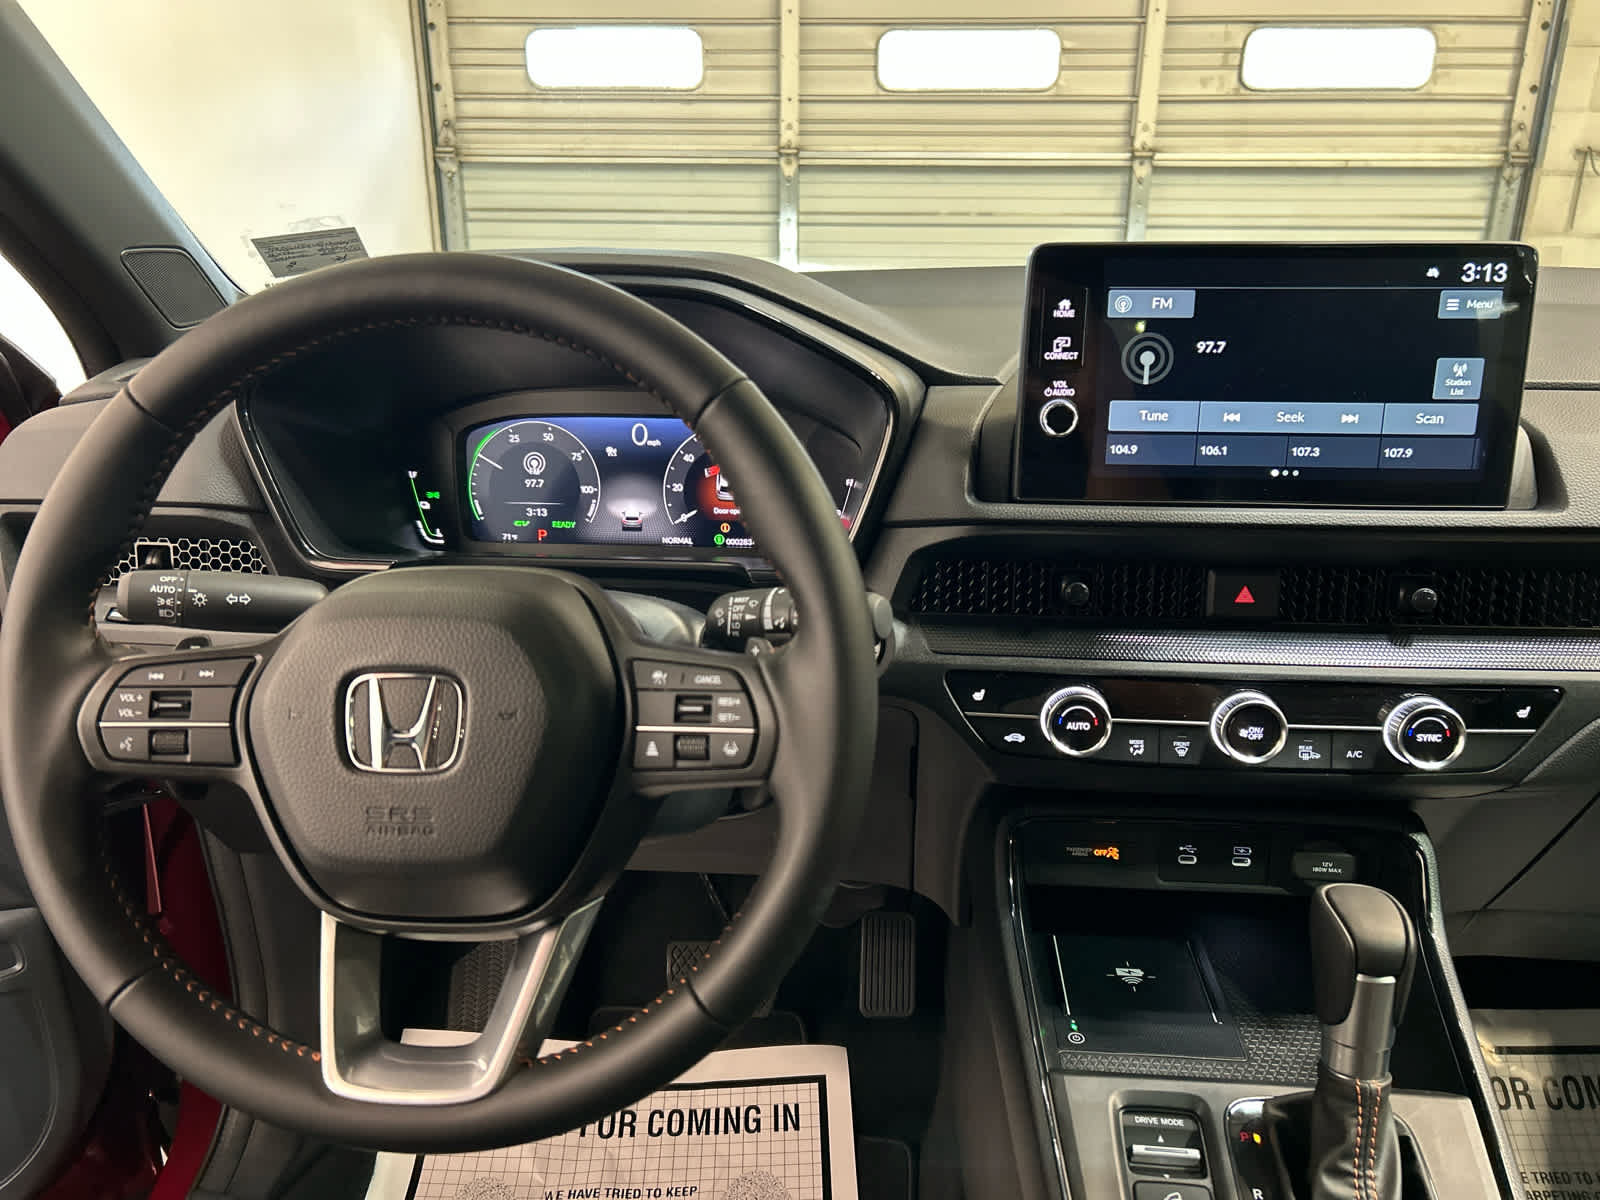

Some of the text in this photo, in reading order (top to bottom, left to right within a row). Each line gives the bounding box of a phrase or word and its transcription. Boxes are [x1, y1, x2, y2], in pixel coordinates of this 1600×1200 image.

[1460, 262, 1508, 283] 3:13
[1151, 297, 1173, 310] FM
[1466, 299, 1494, 309] Menu
[1053, 309, 1076, 318] HOME
[1196, 341, 1226, 354] 97.7
[1044, 351, 1079, 360] CONNECT
[1053, 380, 1068, 388] VOL
[1445, 378, 1472, 387] Station
[1052, 388, 1076, 397] AUDIO
[1450, 388, 1464, 396] List
[1139, 409, 1169, 422] Tune
[1276, 411, 1305, 423] Seek
[1415, 413, 1445, 425] Scan
[509, 434, 520, 443] 25
[543, 433, 554, 442] 50
[631, 423, 648, 446] 0
[1109, 444, 1138, 455] 104.9
[1200, 446, 1228, 456] 106.1
[1291, 447, 1320, 457] 107.3
[1383, 448, 1413, 458] 107.9
[571, 452, 582, 462] 75
[683, 453, 695, 463] 40
[524, 479, 545, 488] 97.7
[672, 483, 684, 492] 20
[580, 486, 594, 494] 100
[526, 508, 548, 517] 3:13
[537, 529, 548, 541] P
[662, 536, 693, 544] NORMAL
[150, 585, 175, 593] AUTO
[694, 674, 722, 685] CANCEL
[119, 693, 135, 702] VOL
[118, 708, 134, 717] VOL
[1066, 722, 1091, 731] AUTO
[1416, 733, 1443, 743] SYNC
[1347, 750, 1362, 759] A/C
[1094, 848, 1108, 856] OFF
[647, 1104, 761, 1137] COMING
[773, 1103, 800, 1132] IN
[1134, 1115, 1184, 1127] DRIVE MODE
[1239, 1131, 1249, 1142] P
[1531, 1171, 1570, 1185] TRIED
[1573, 1171, 1592, 1185] TO
[567, 1188, 601, 1200] HAVE
[604, 1187, 642, 1199] TRIED
[645, 1188, 662, 1199] TO
[665, 1185, 698, 1198] KEEP
[1252, 1188, 1264, 1200] R
